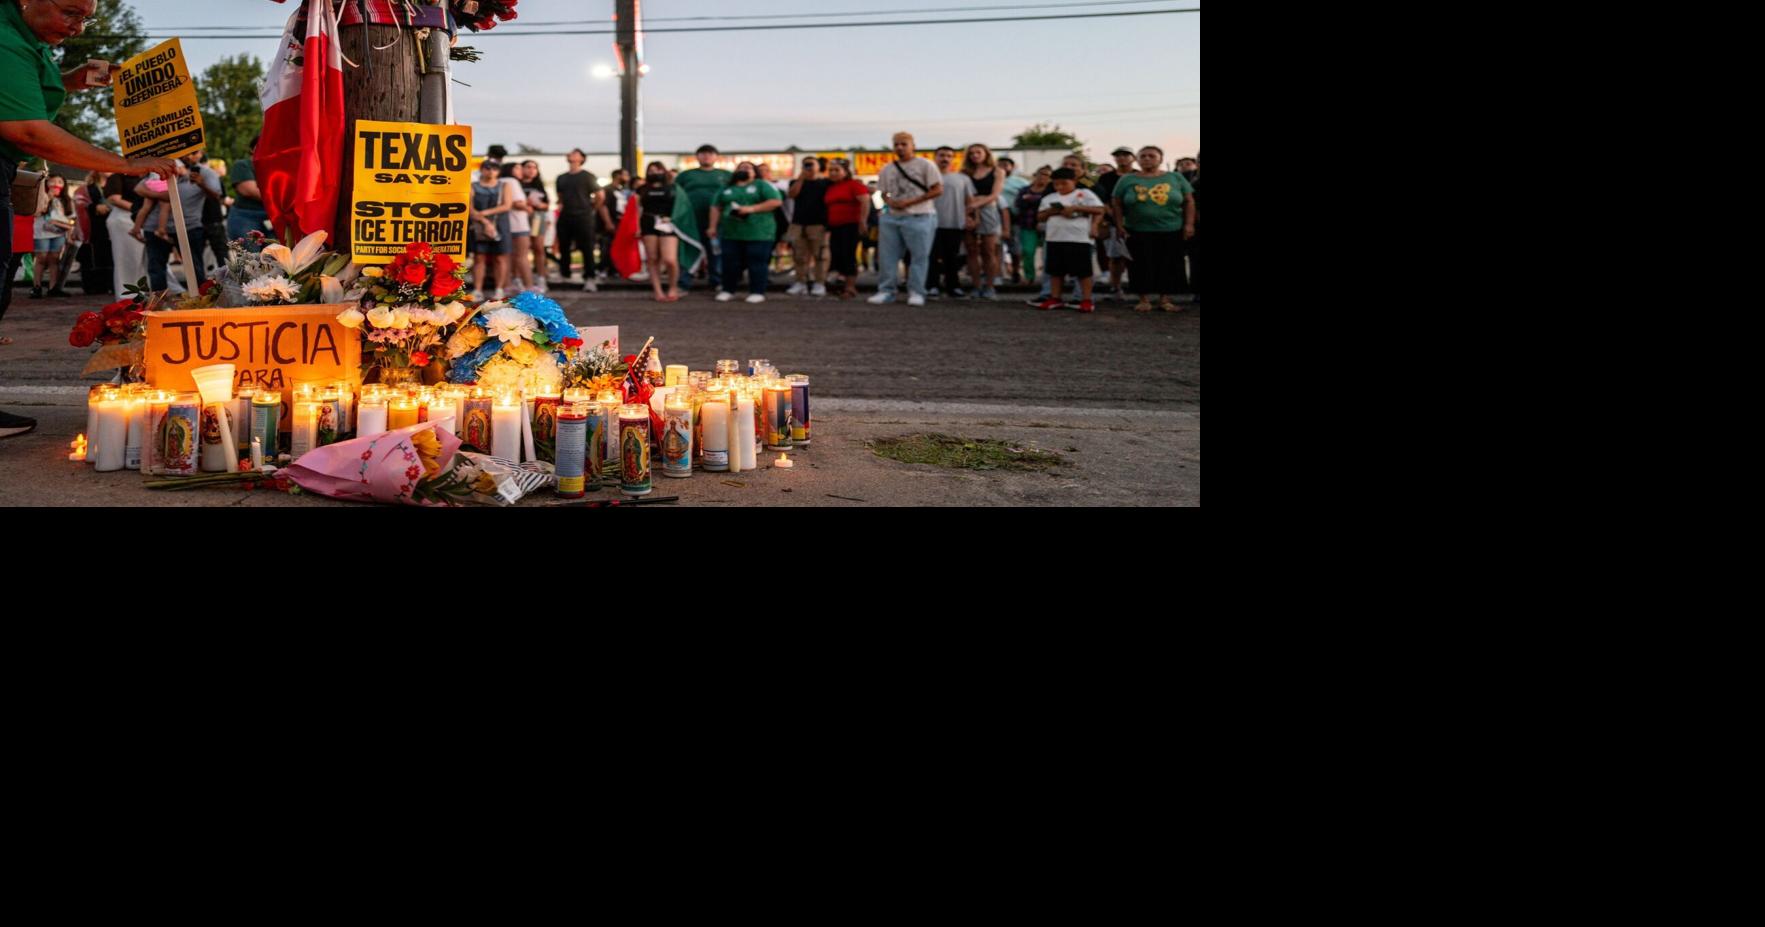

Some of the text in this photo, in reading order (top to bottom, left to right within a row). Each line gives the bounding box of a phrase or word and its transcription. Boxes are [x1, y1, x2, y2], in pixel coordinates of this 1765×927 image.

[135, 47, 176, 74] PUEBLO
[125, 62, 176, 96] UNIDO
[124, 105, 194, 138] A LAS FAMILIAS
[125, 115, 196, 148] MIGRANTES!
[359, 130, 467, 172] TEXAS
[374, 173, 451, 185] SAYS:
[354, 201, 467, 219] STOP
[354, 219, 464, 242] ICE TERROR
[355, 245, 375, 254] PARTY
[375, 245, 388, 254] FOR
[388, 245, 407, 254] SOCIA
[161, 320, 341, 366] JUSTICIA
